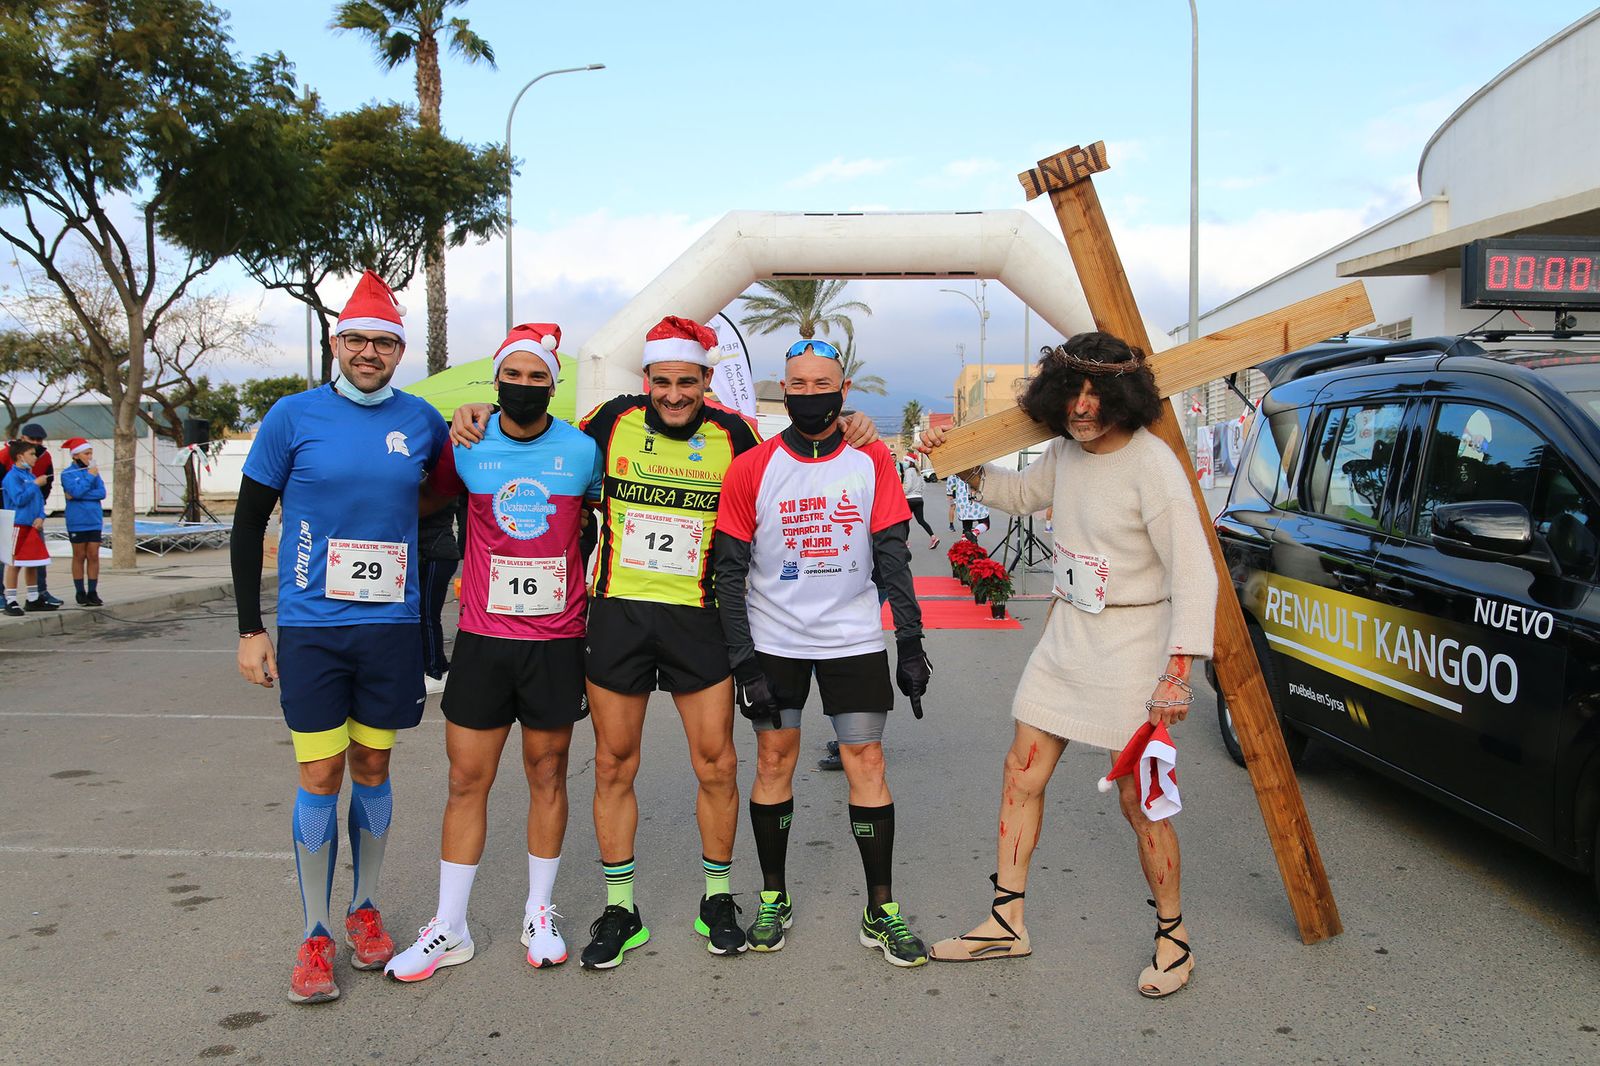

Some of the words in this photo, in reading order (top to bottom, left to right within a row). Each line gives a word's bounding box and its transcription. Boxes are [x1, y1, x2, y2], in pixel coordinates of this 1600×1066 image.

[1028, 143, 1103, 196] INRI
[646, 464, 669, 475] AGRO
[669, 467, 684, 477] SAN
[517, 486, 535, 497] Los
[615, 483, 676, 505] NATURA
[682, 492, 718, 510] BIKE
[779, 500, 796, 514] XII
[799, 496, 827, 512] SAN
[645, 514, 672, 522] SILVESTRE
[781, 512, 825, 525] SILVESTRE
[782, 525, 820, 537] COMARCA
[822, 524, 832, 533] DE
[644, 532, 674, 553] 12
[351, 561, 383, 580] 29
[1066, 568, 1073, 586] 1
[508, 577, 538, 595] 16
[1473, 598, 1554, 640] NUEVO
[1265, 586, 1367, 652] RENAULT
[1374, 617, 1519, 704] KANGOO
[1316, 693, 1326, 704] en
[1325, 693, 1346, 712] Syrsa
